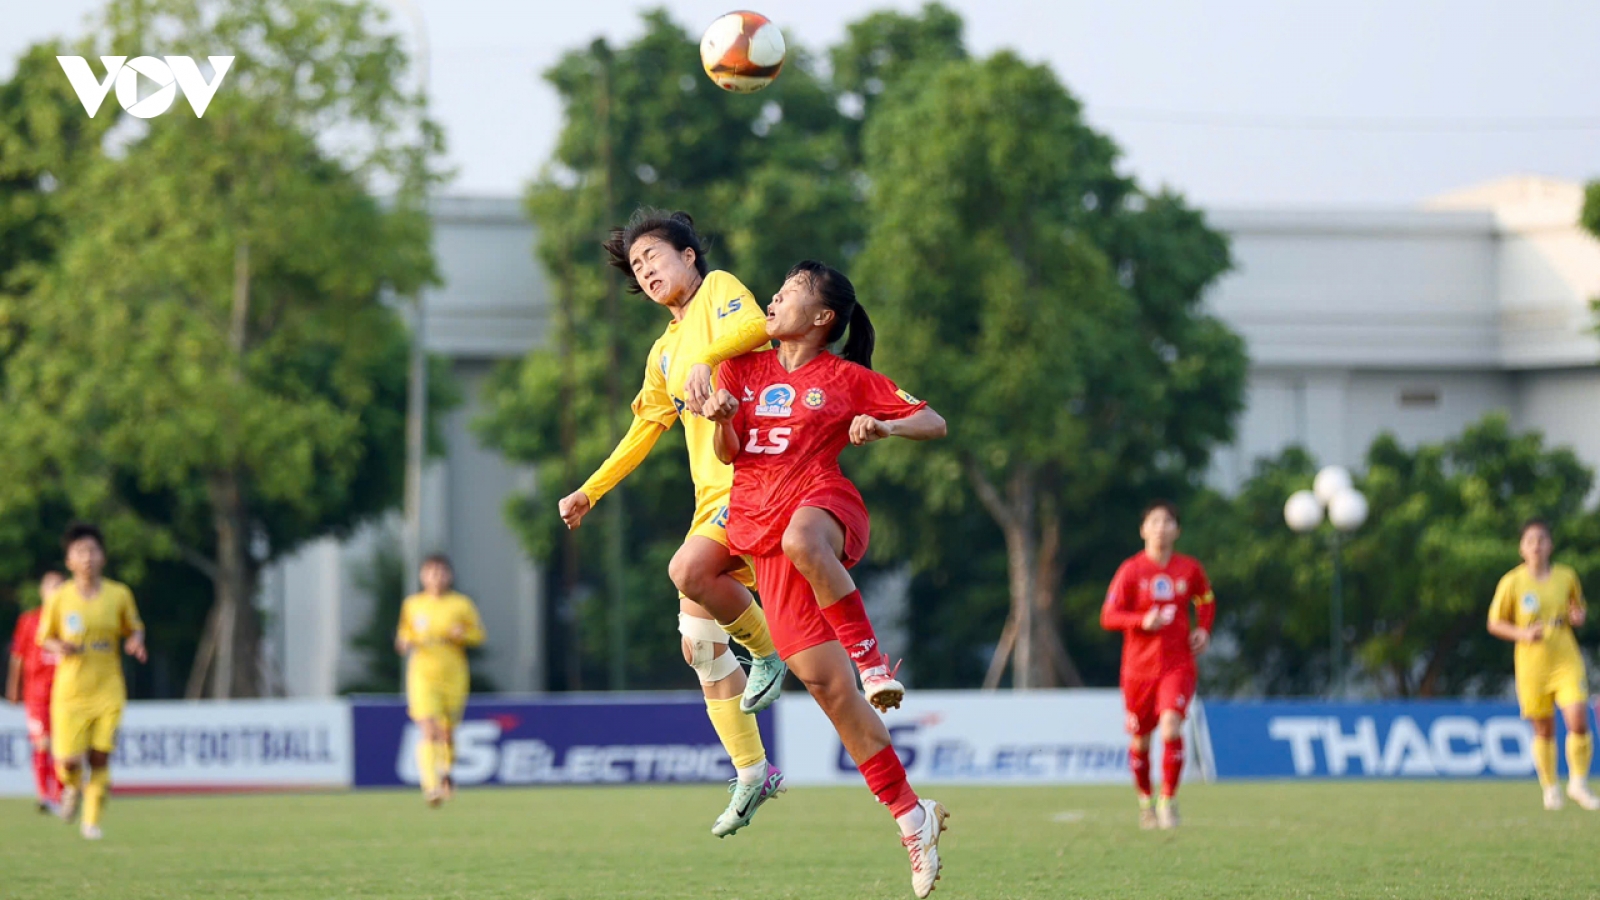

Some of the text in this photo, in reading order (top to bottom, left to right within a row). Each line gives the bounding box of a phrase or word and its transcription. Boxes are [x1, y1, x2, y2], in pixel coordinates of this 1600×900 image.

[717, 297, 742, 319] LS
[744, 427, 792, 455] LS
[928, 739, 1128, 777] ELECTRI
[1268, 715, 1537, 777] THACO
